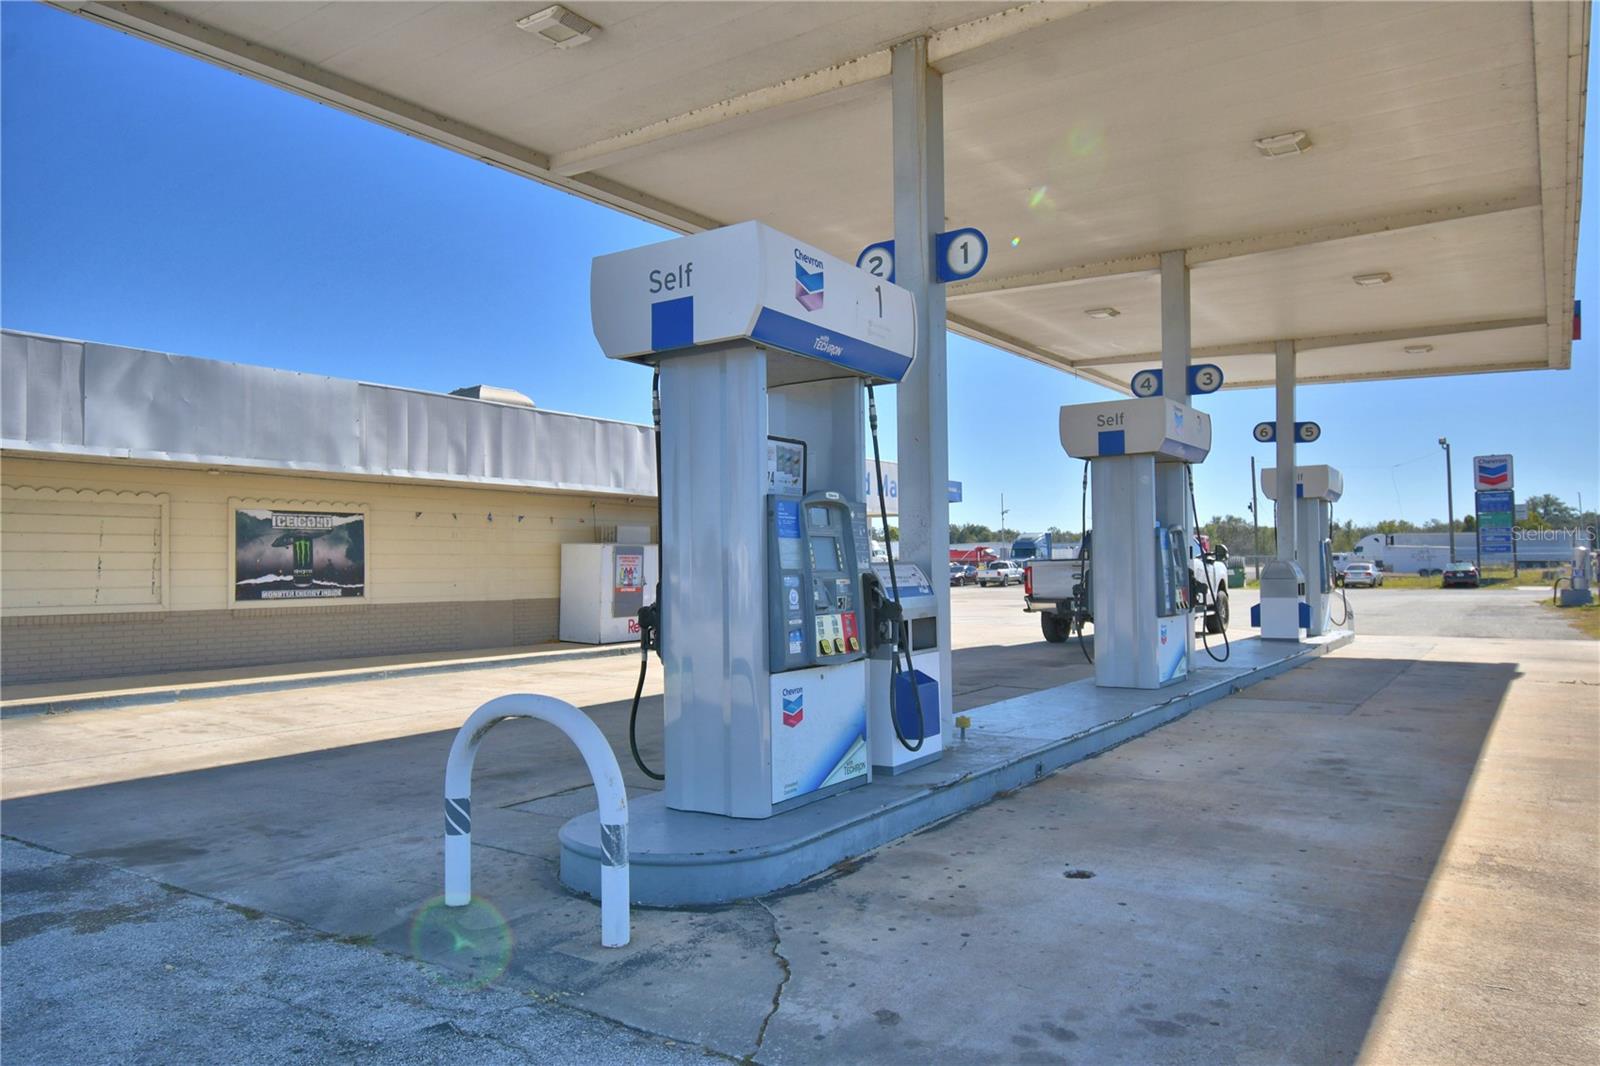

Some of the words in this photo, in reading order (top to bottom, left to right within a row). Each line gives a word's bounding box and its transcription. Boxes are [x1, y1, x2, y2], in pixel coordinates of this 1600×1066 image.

[795, 248, 824, 269] Chevron
[960, 242, 968, 264] 1
[869, 256, 883, 277] 2
[649, 262, 693, 293] Self
[875, 285, 882, 318] 1
[814, 338, 843, 356] TECHRON
[1140, 378, 1152, 391] 4
[1203, 373, 1213, 385] 3
[1096, 412, 1125, 427] Self
[1260, 428, 1268, 438] 6
[1305, 427, 1314, 437] 5
[782, 687, 803, 697] Chevron
[844, 763, 866, 776] TECHRON
